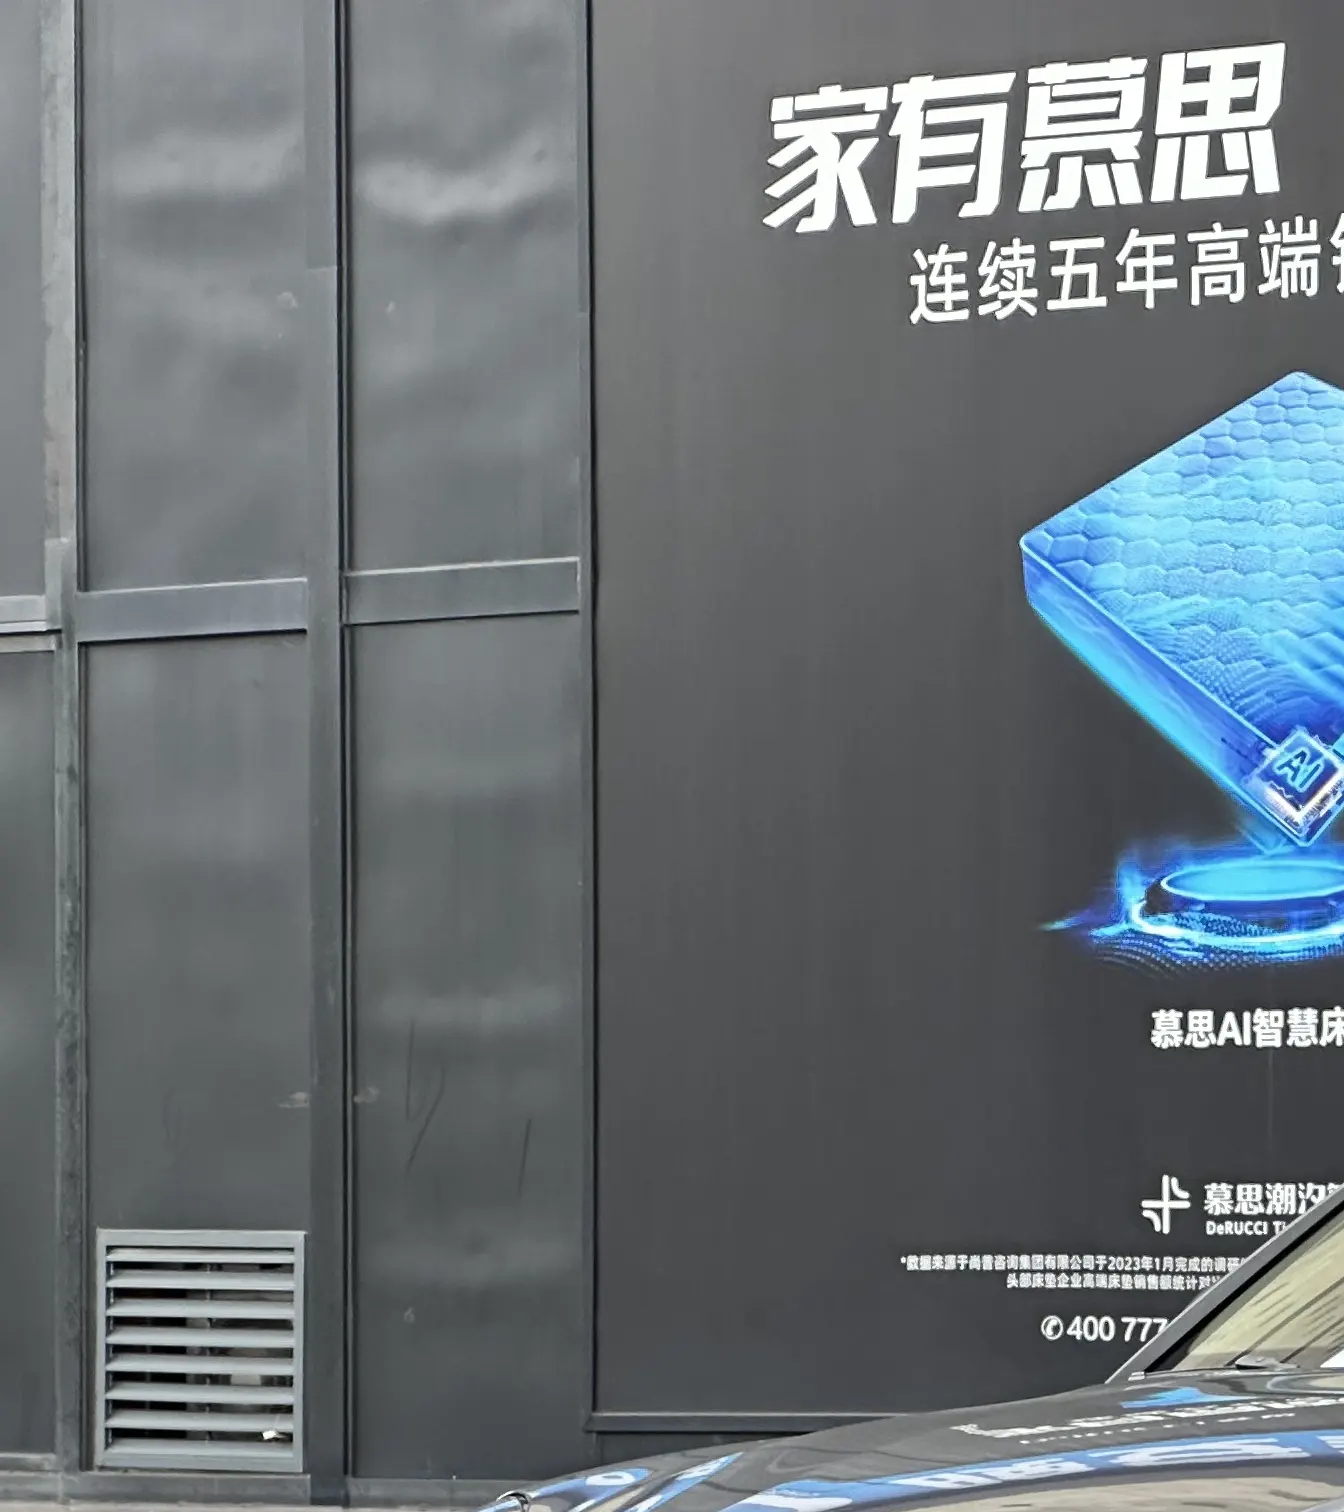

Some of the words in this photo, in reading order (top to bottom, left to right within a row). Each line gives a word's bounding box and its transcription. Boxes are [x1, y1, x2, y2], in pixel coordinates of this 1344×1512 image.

[762, 41, 1286, 233] 家有慕思
[1275, 749, 1323, 792] AI
[1205, 1220, 1268, 1235] DeRUCCI
[1066, 1315, 1116, 1341] 400
[1120, 1316, 1168, 1342] 777
